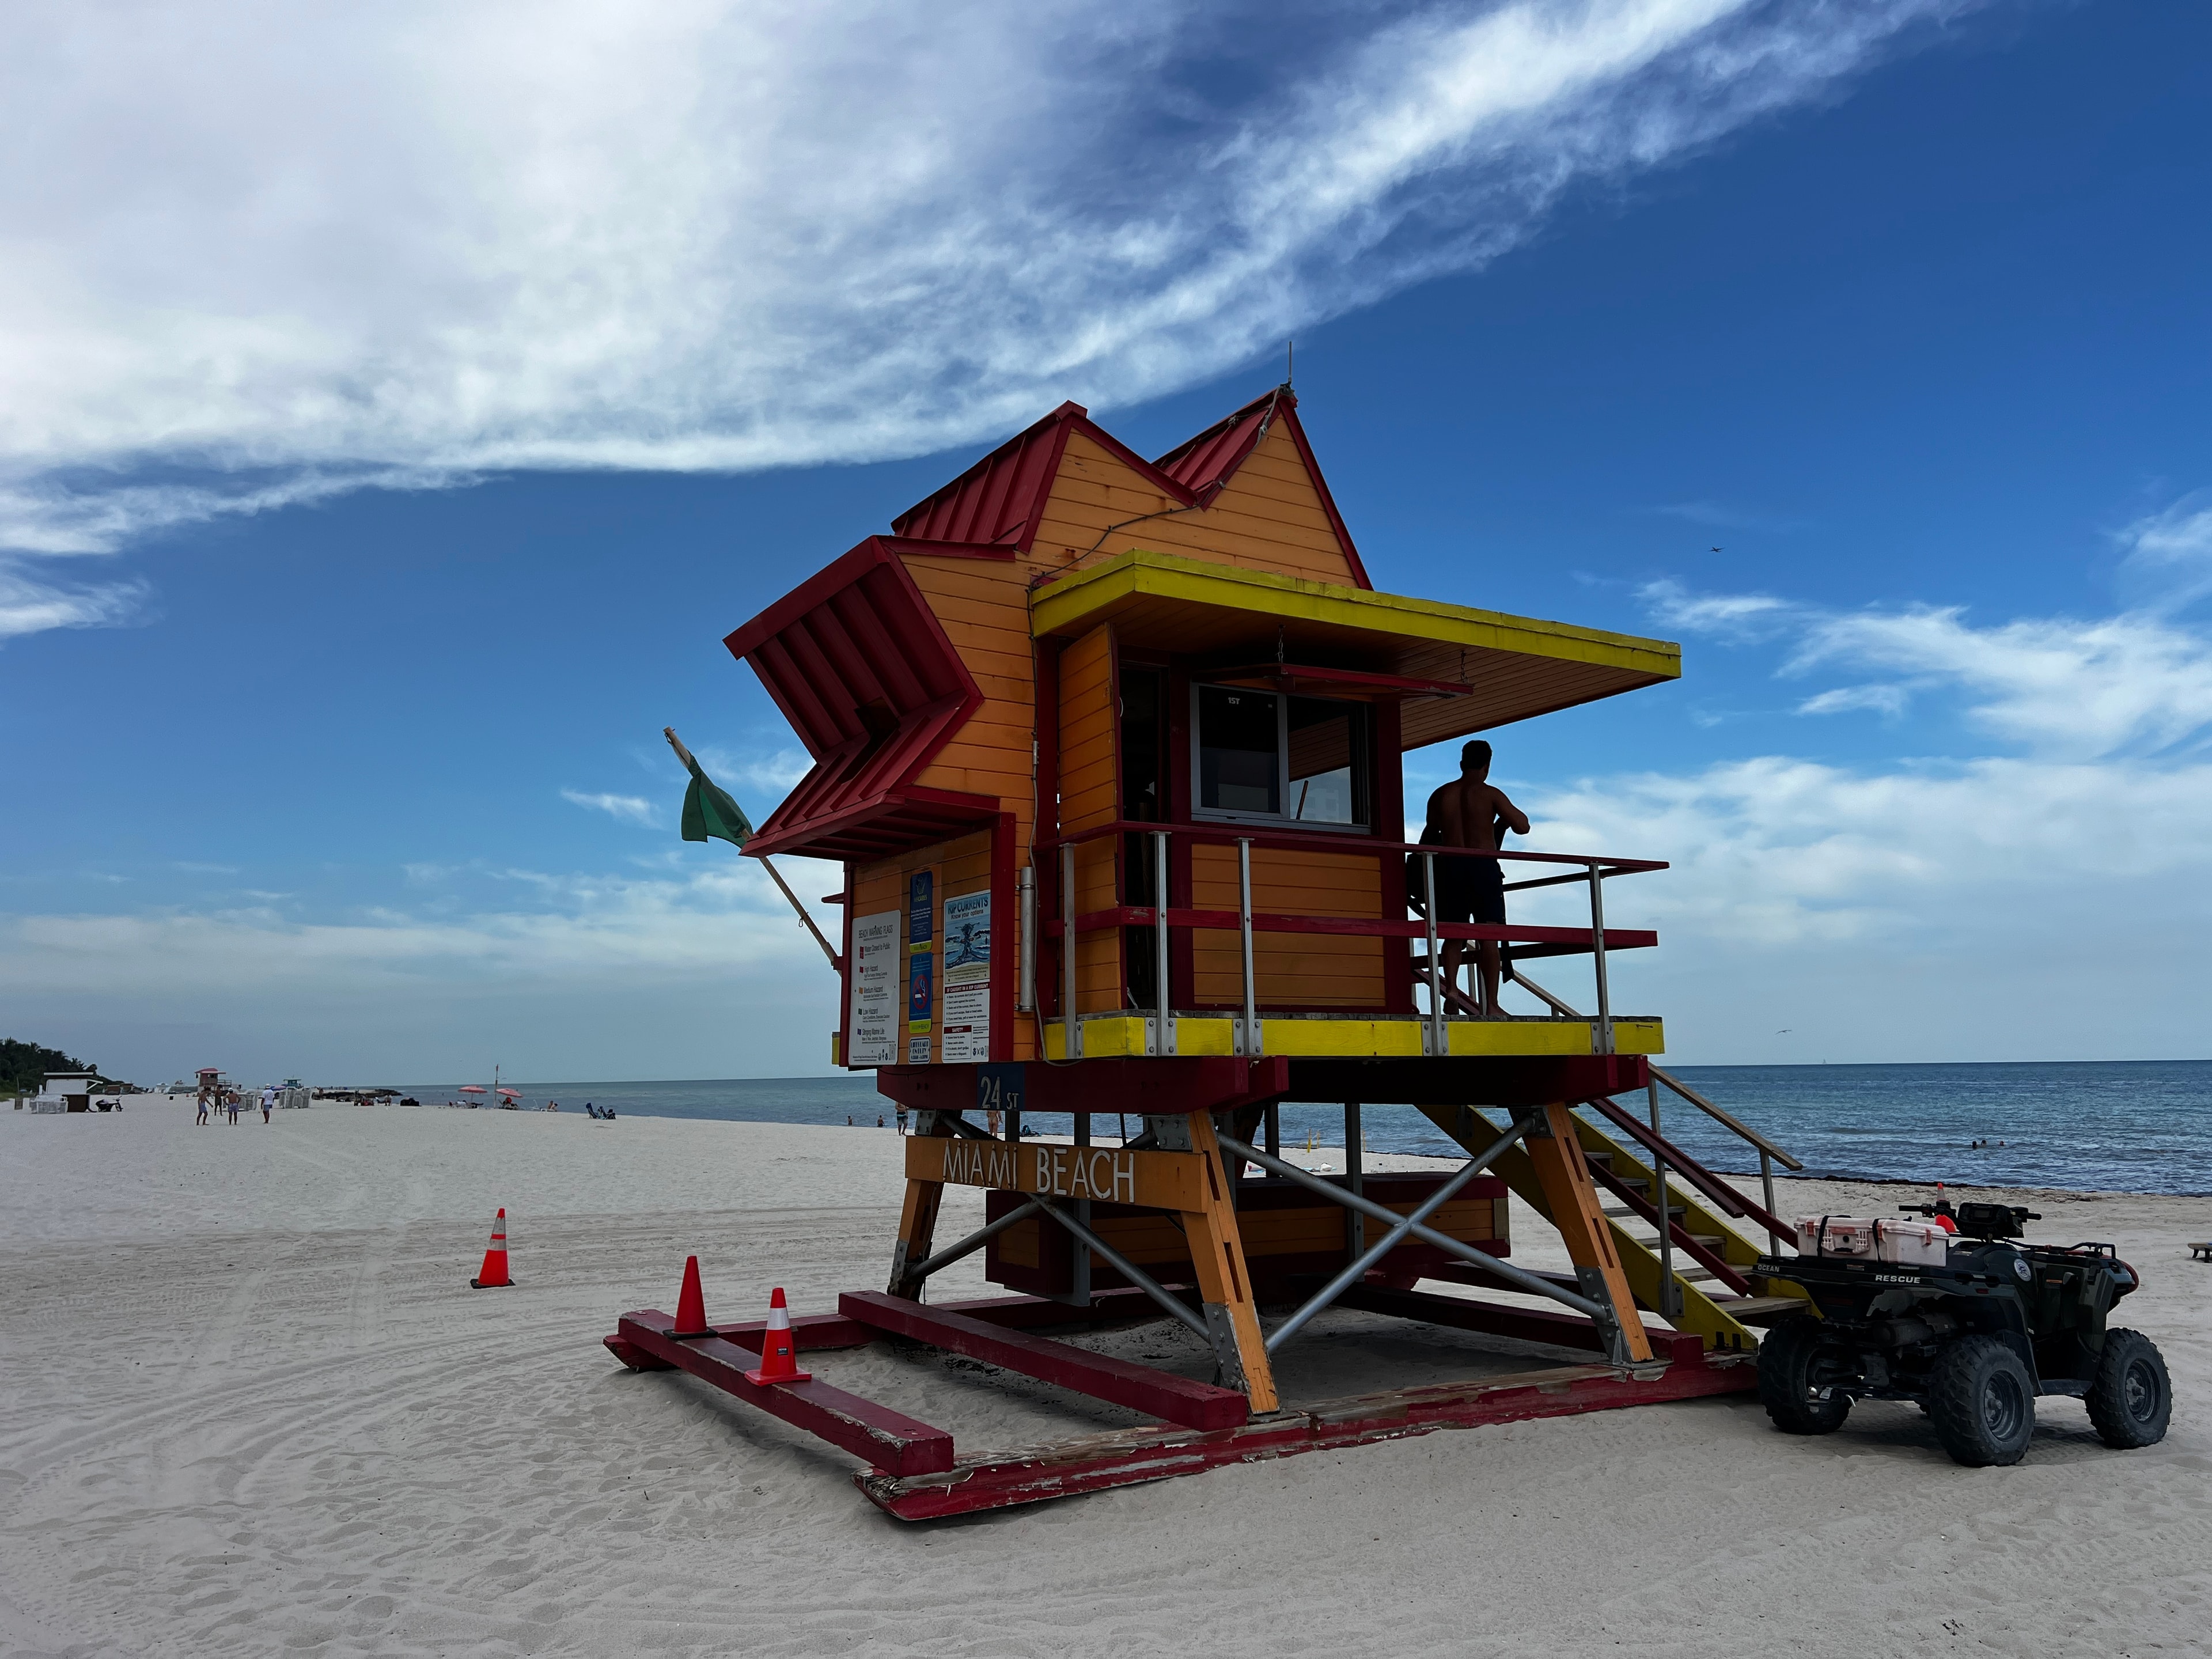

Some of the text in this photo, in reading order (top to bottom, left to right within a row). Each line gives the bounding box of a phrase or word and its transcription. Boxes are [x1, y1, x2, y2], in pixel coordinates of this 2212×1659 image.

[948, 897, 988, 915] RIP CURRENTS
[970, 909, 984, 917] options
[858, 929, 869, 939] BEACH
[883, 924, 893, 934] FLAGS
[980, 1075, 1020, 1111] 24 ST
[942, 1141, 1135, 1203] MIAMI BEACH
[1758, 1264, 1921, 1283] OCEAN RESCUE
